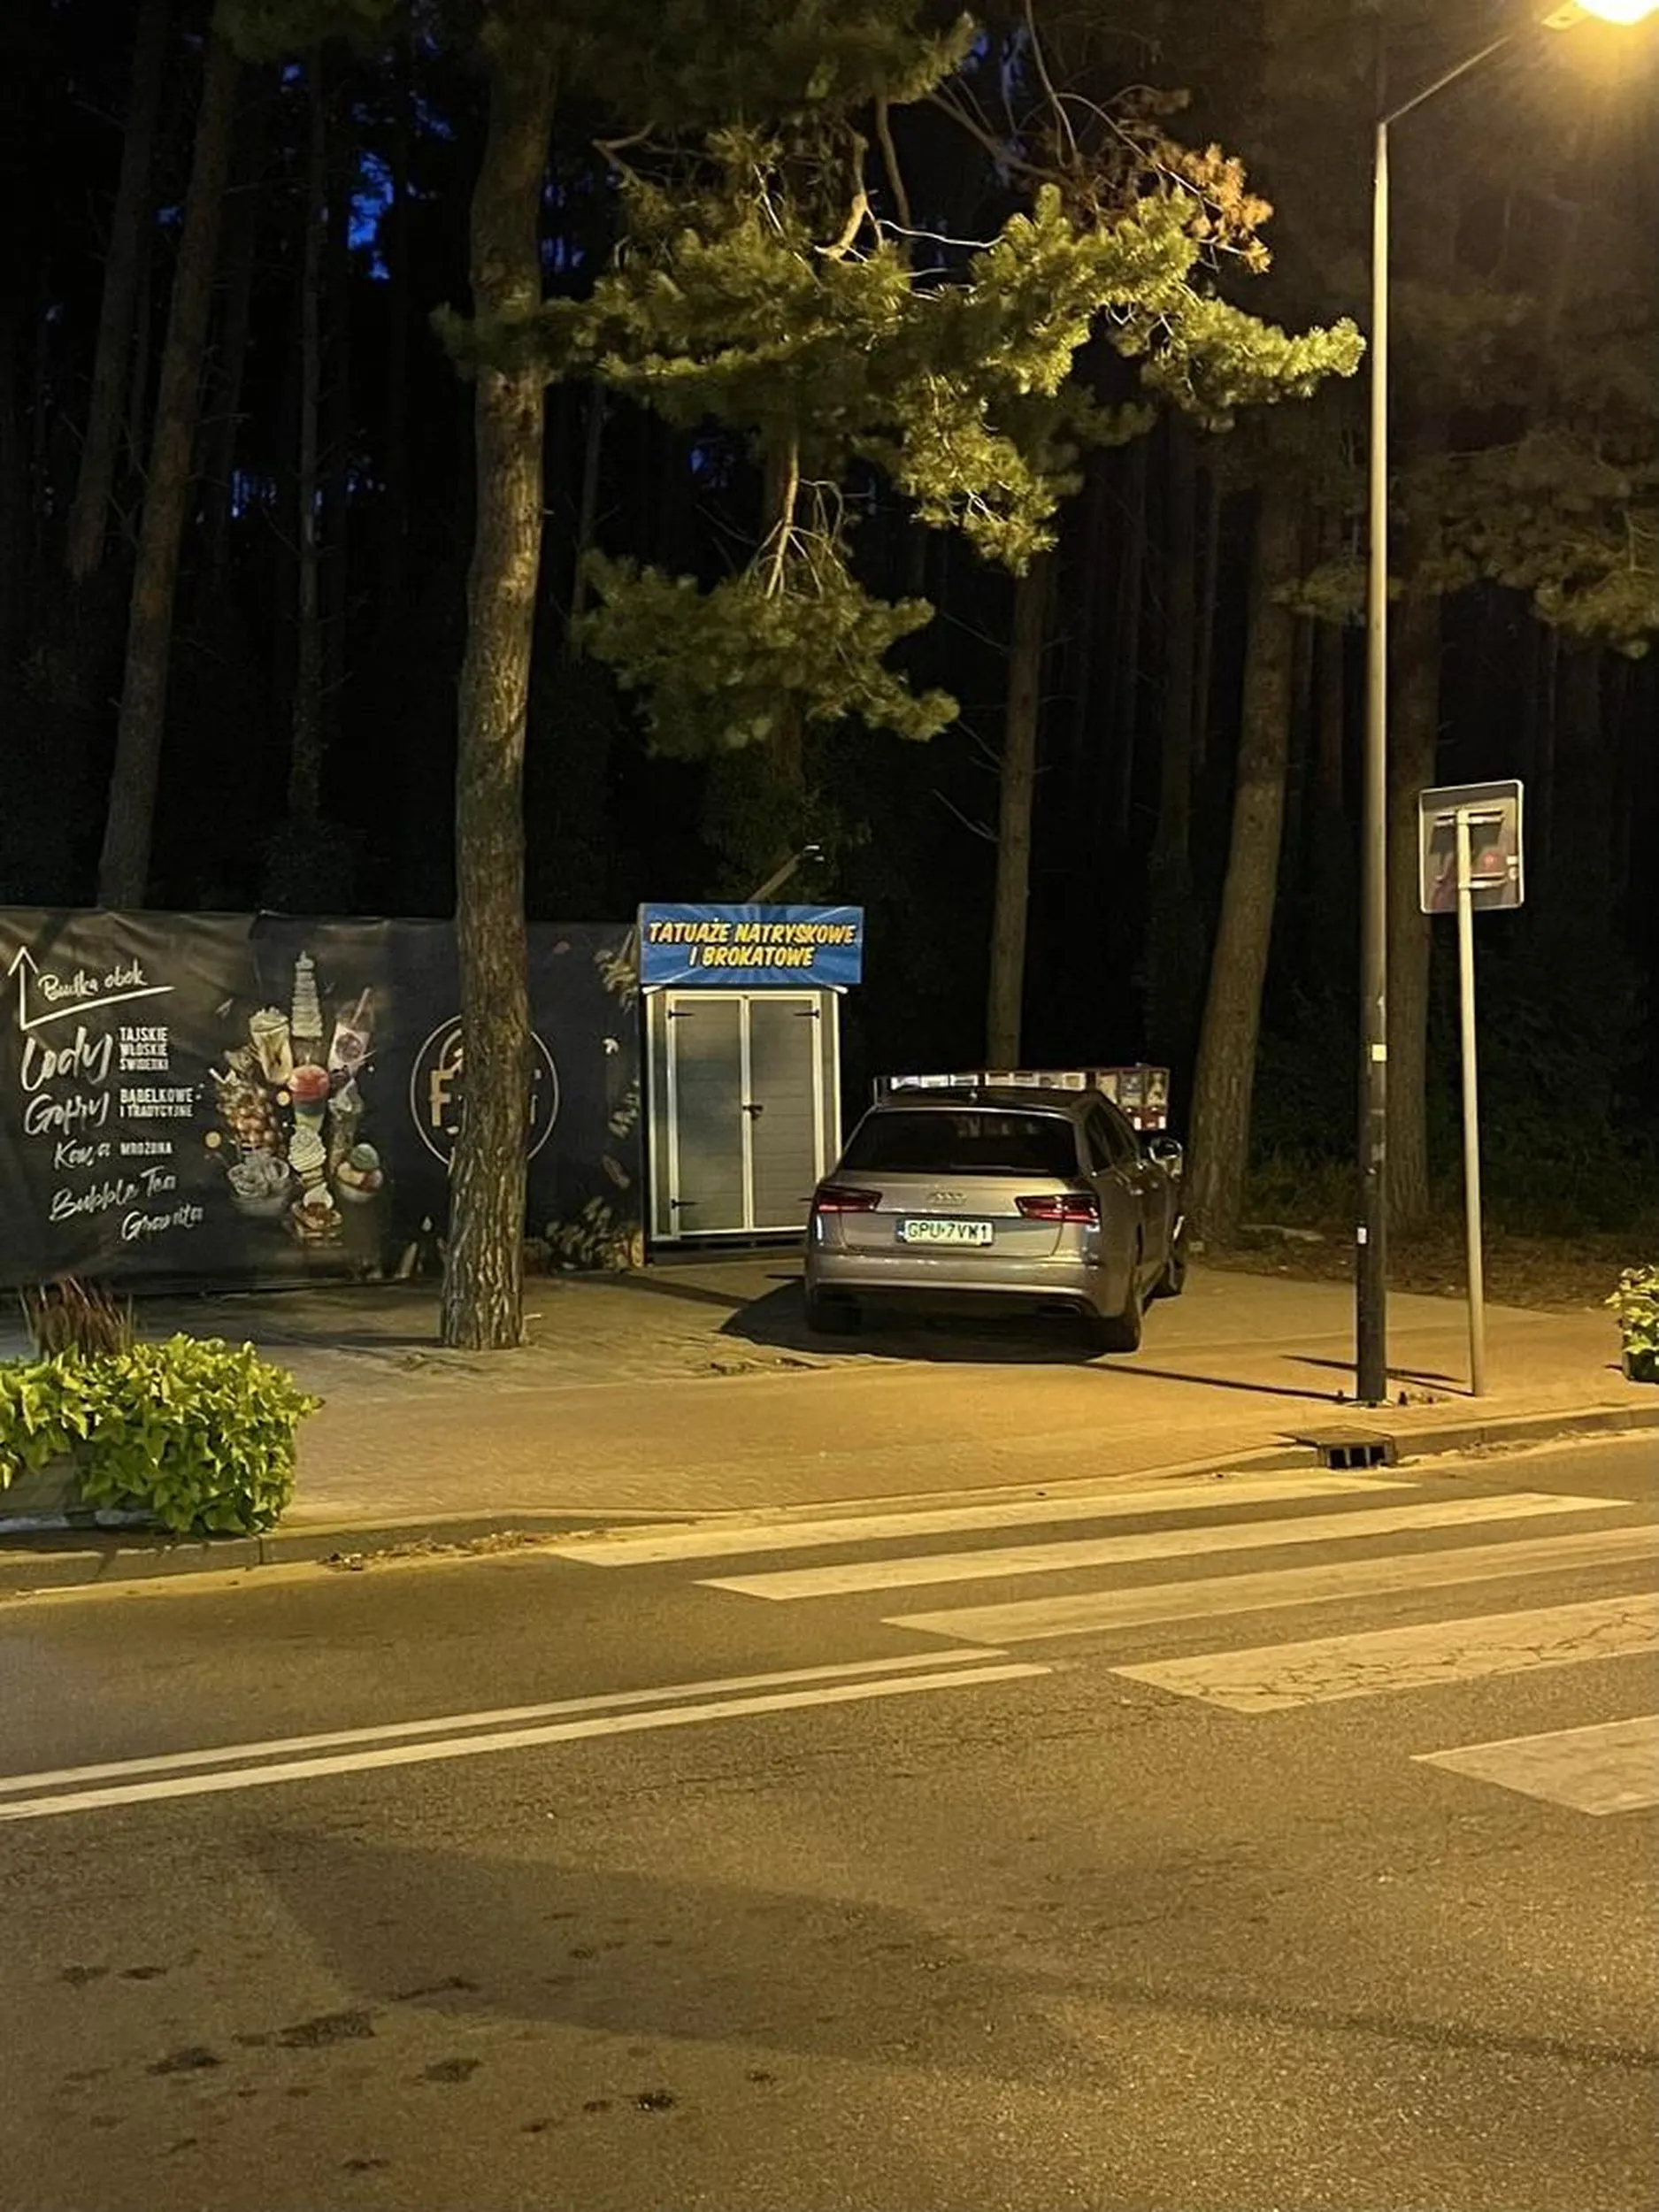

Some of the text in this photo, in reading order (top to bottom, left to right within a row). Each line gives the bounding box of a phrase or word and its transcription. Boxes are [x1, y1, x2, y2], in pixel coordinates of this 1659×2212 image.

[649, 918, 856, 945] TATUAŻE NATRYSKOWE
[688, 946, 816, 968] I BROKATOWE
[38, 958, 148, 1001] Budka obok
[119, 1027, 169, 1041] TAJSKIE
[21, 1026, 113, 1092] Lody
[119, 1087, 194, 1106] BĄBELKOWE
[119, 1104, 194, 1118] I TRADYCYJNE
[25, 1092, 110, 1136] Gofry
[54, 1139, 111, 1170] Kawa
[49, 1165, 176, 1221] Bubble Tea
[121, 1203, 204, 1240] Granita
